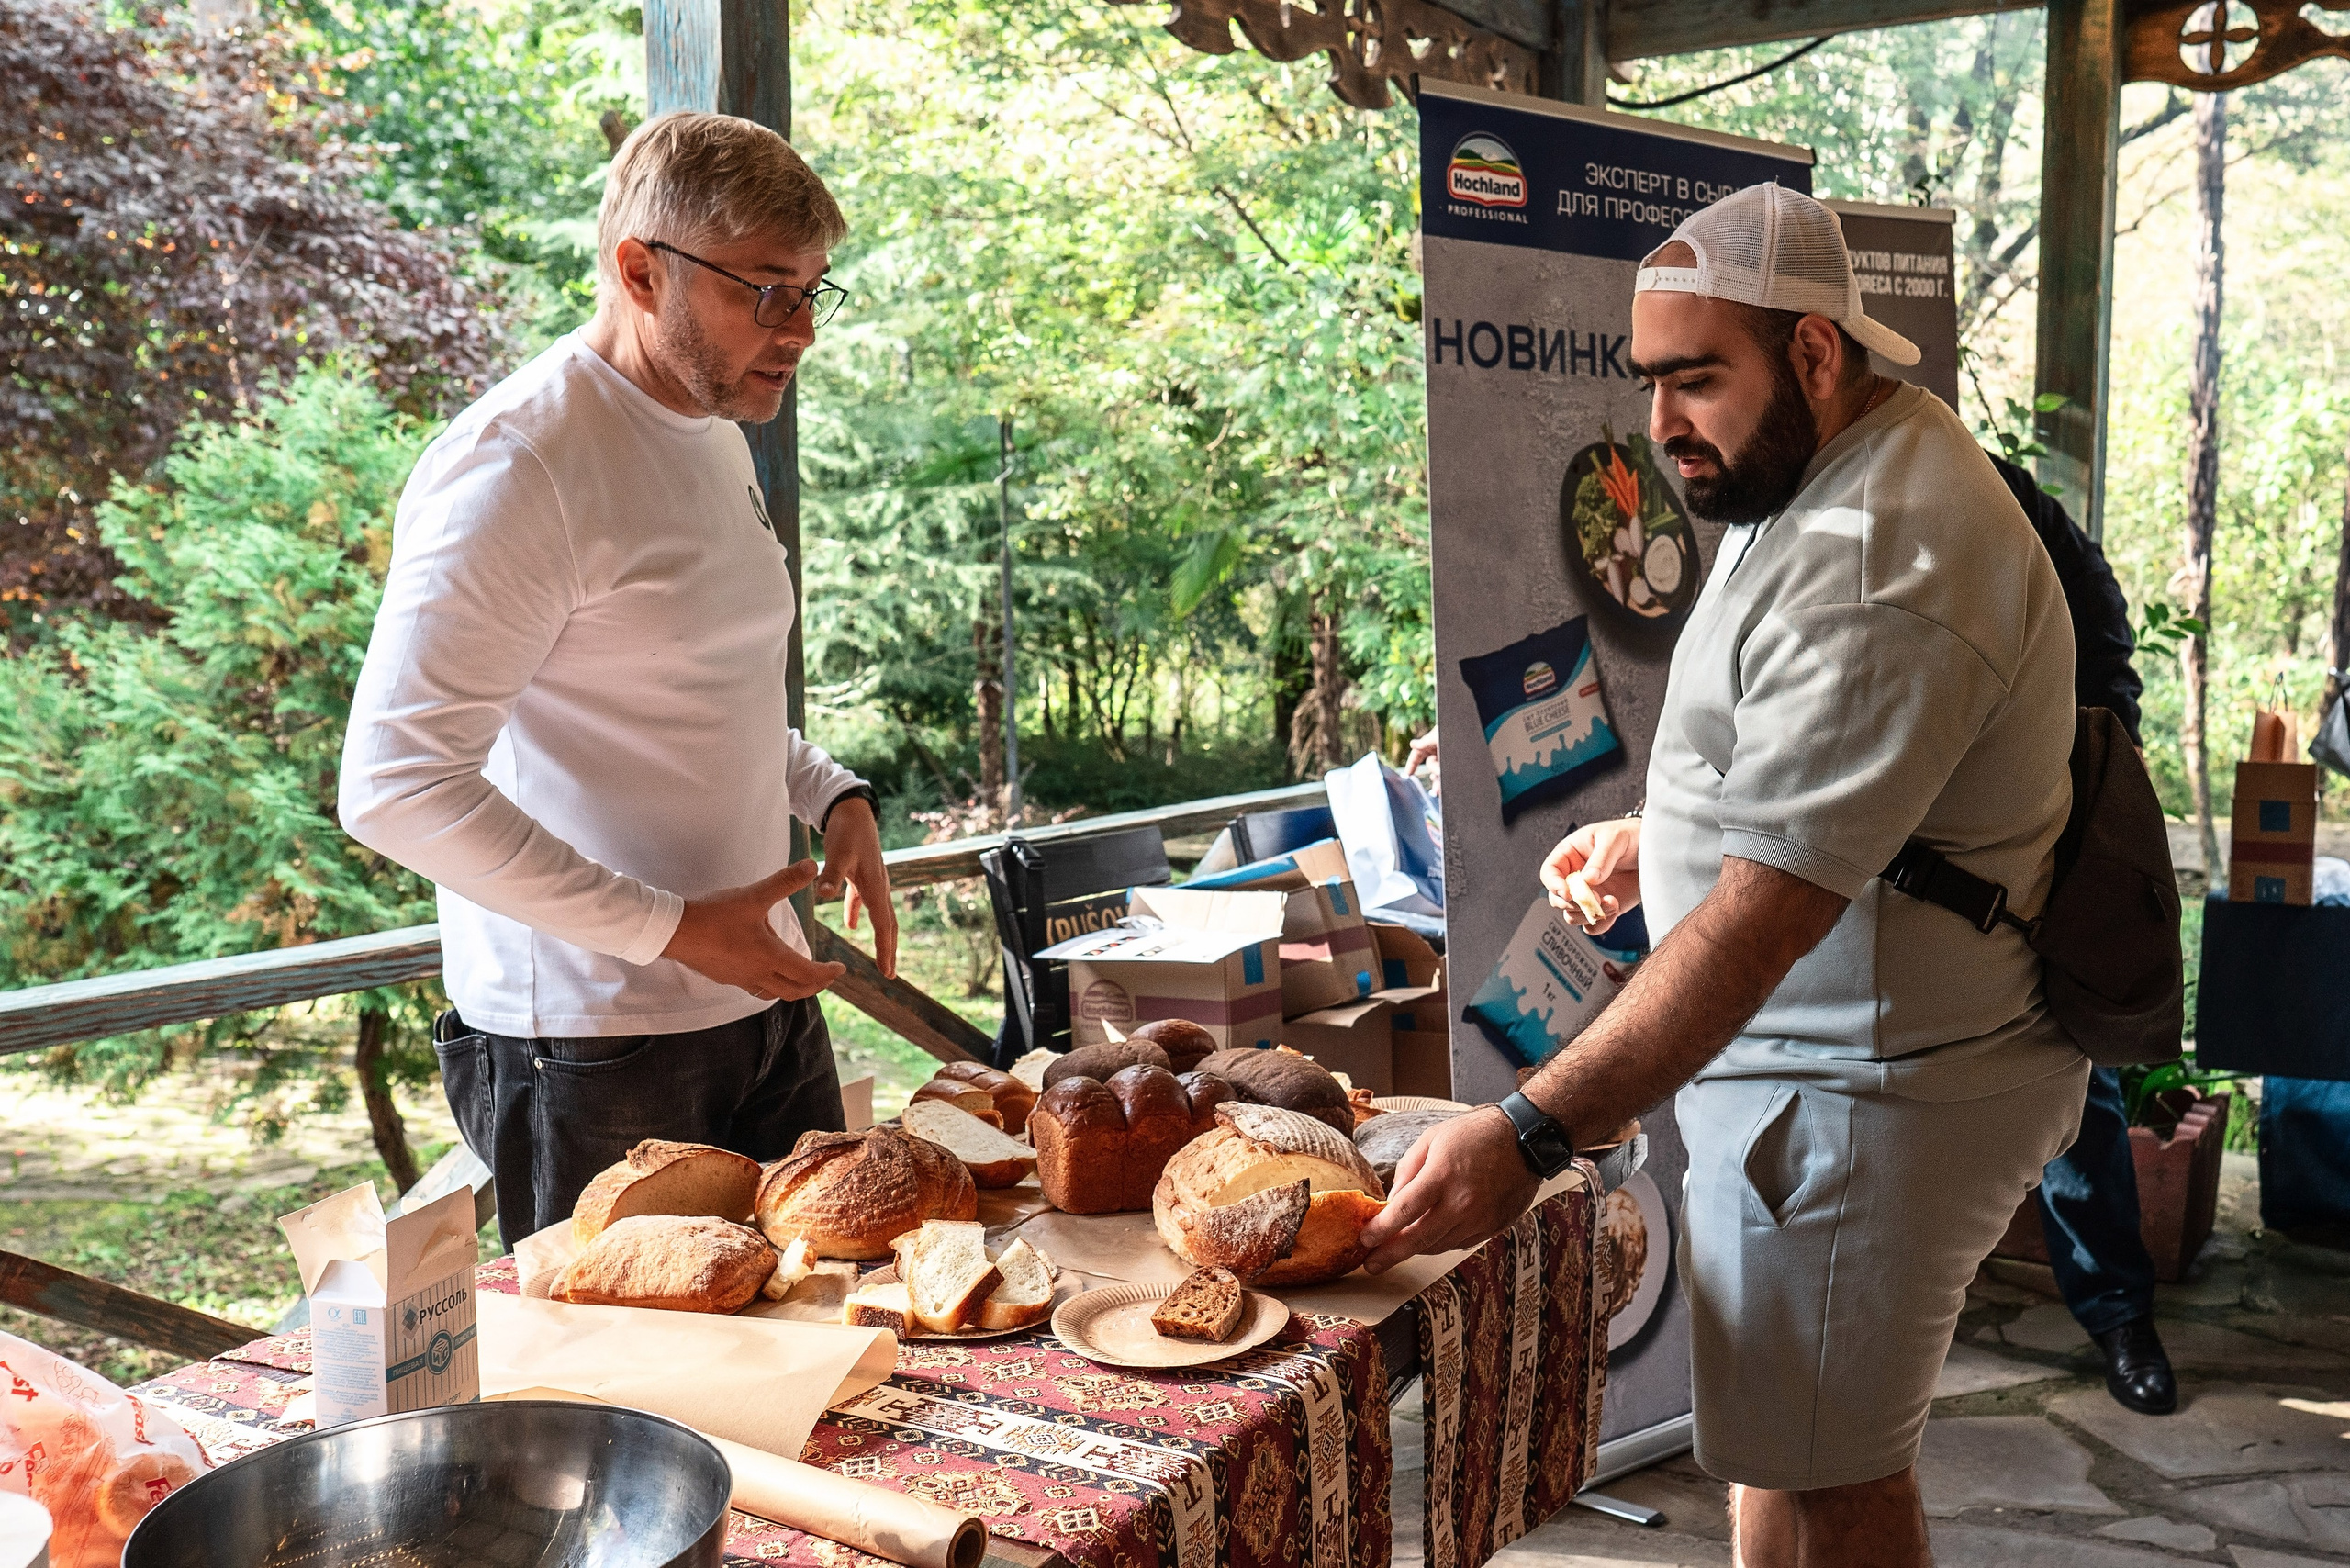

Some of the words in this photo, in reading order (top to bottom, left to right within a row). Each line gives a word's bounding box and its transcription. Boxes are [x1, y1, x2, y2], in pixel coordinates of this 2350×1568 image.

[1453, 172, 1521, 197] Hochland
[1584, 162, 1673, 196] ЭКСПЕРТ
[1676, 177, 1690, 200] В
[1694, 180, 1742, 204] СЫР
[1447, 204, 1529, 224] PROFESSIONAL
[1556, 189, 1599, 218] ДЛЯ
[1848, 249, 1891, 272] УКТОВ
[1433, 317, 1641, 380] НОВИНК
[1542, 930, 1594, 991] СЛИВОЧНЫЙ
[419, 1287, 467, 1325] РУССОЛЬ
[391, 1358, 423, 1377] ПИЩЕВАЯ
